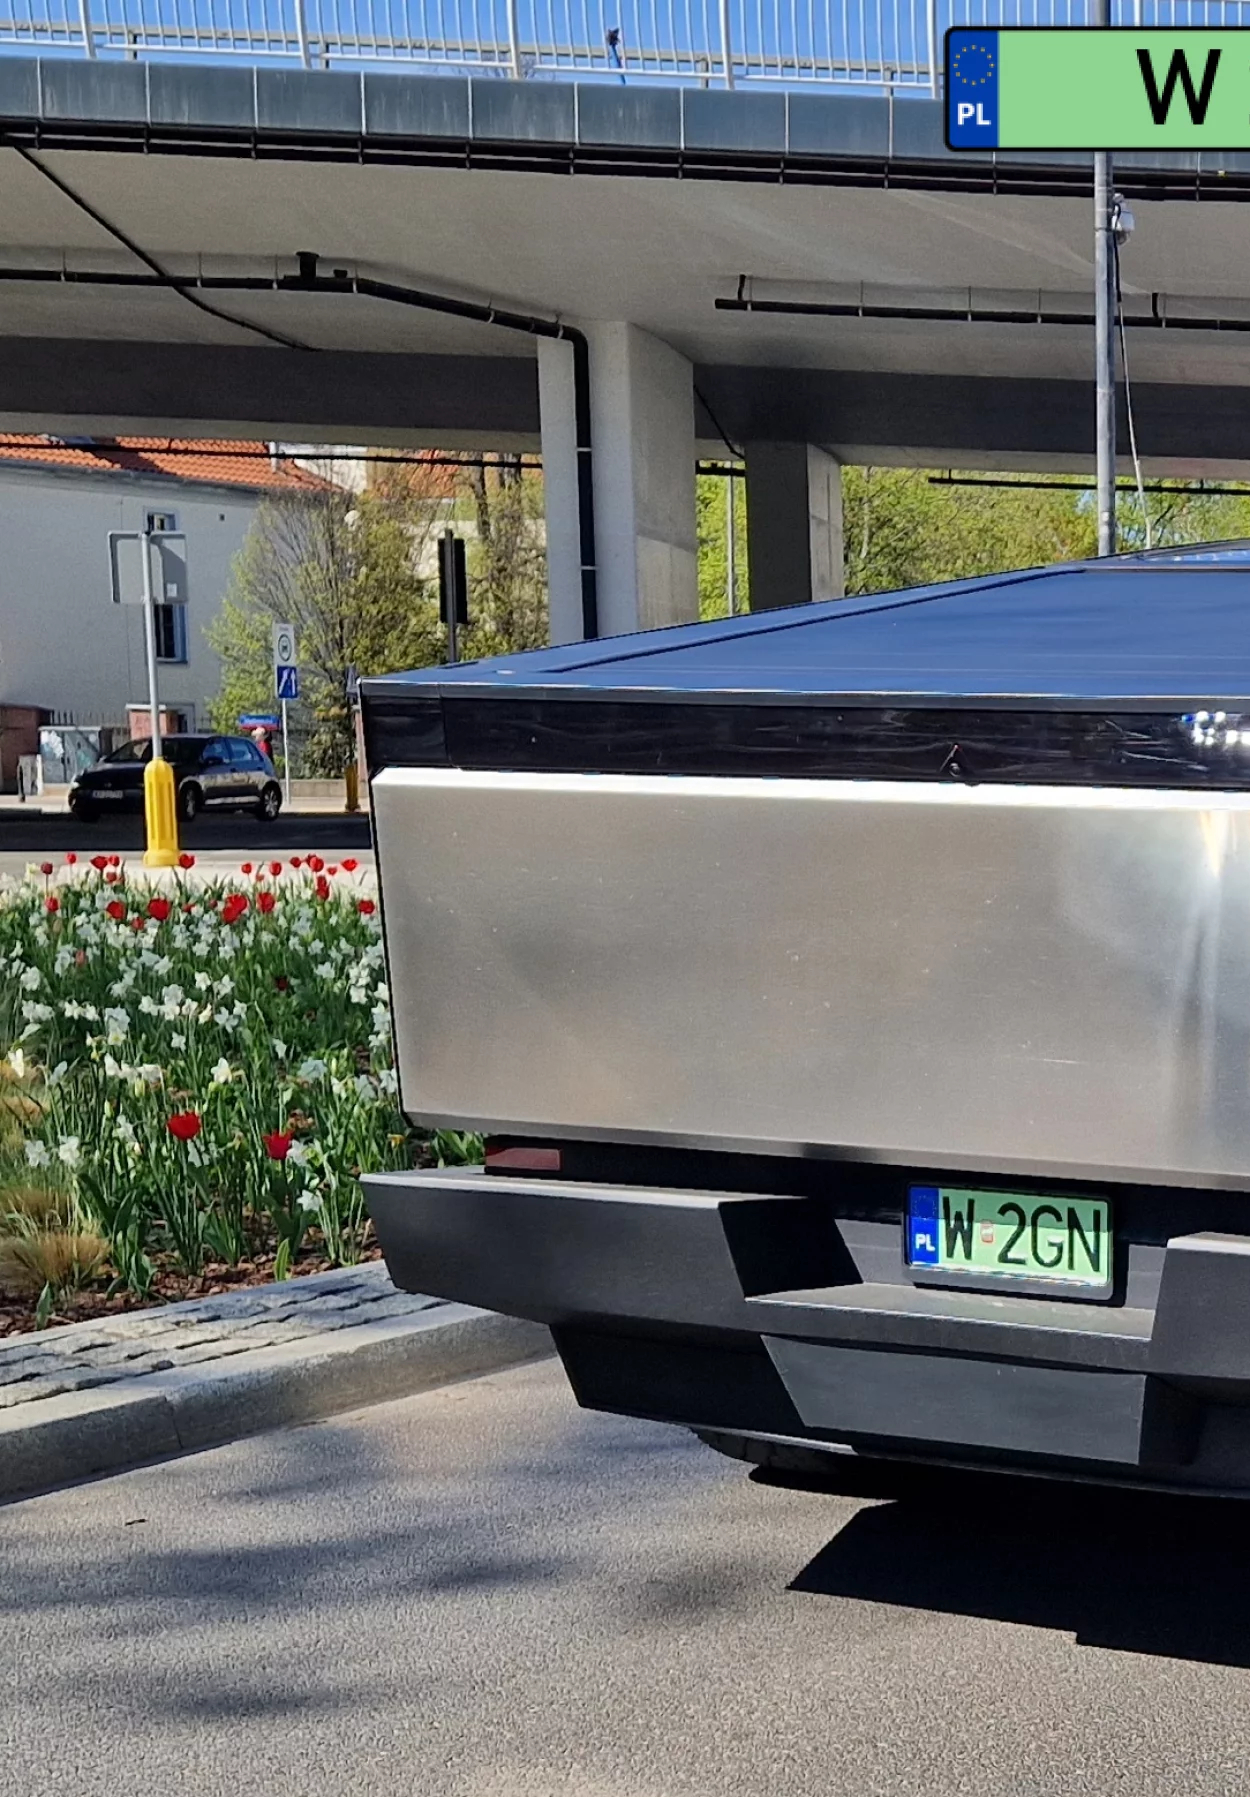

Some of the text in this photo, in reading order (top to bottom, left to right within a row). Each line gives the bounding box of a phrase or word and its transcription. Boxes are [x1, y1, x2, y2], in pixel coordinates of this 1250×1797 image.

[915, 1233, 936, 1252] PL
[942, 1196, 1101, 1272] W 2GN
